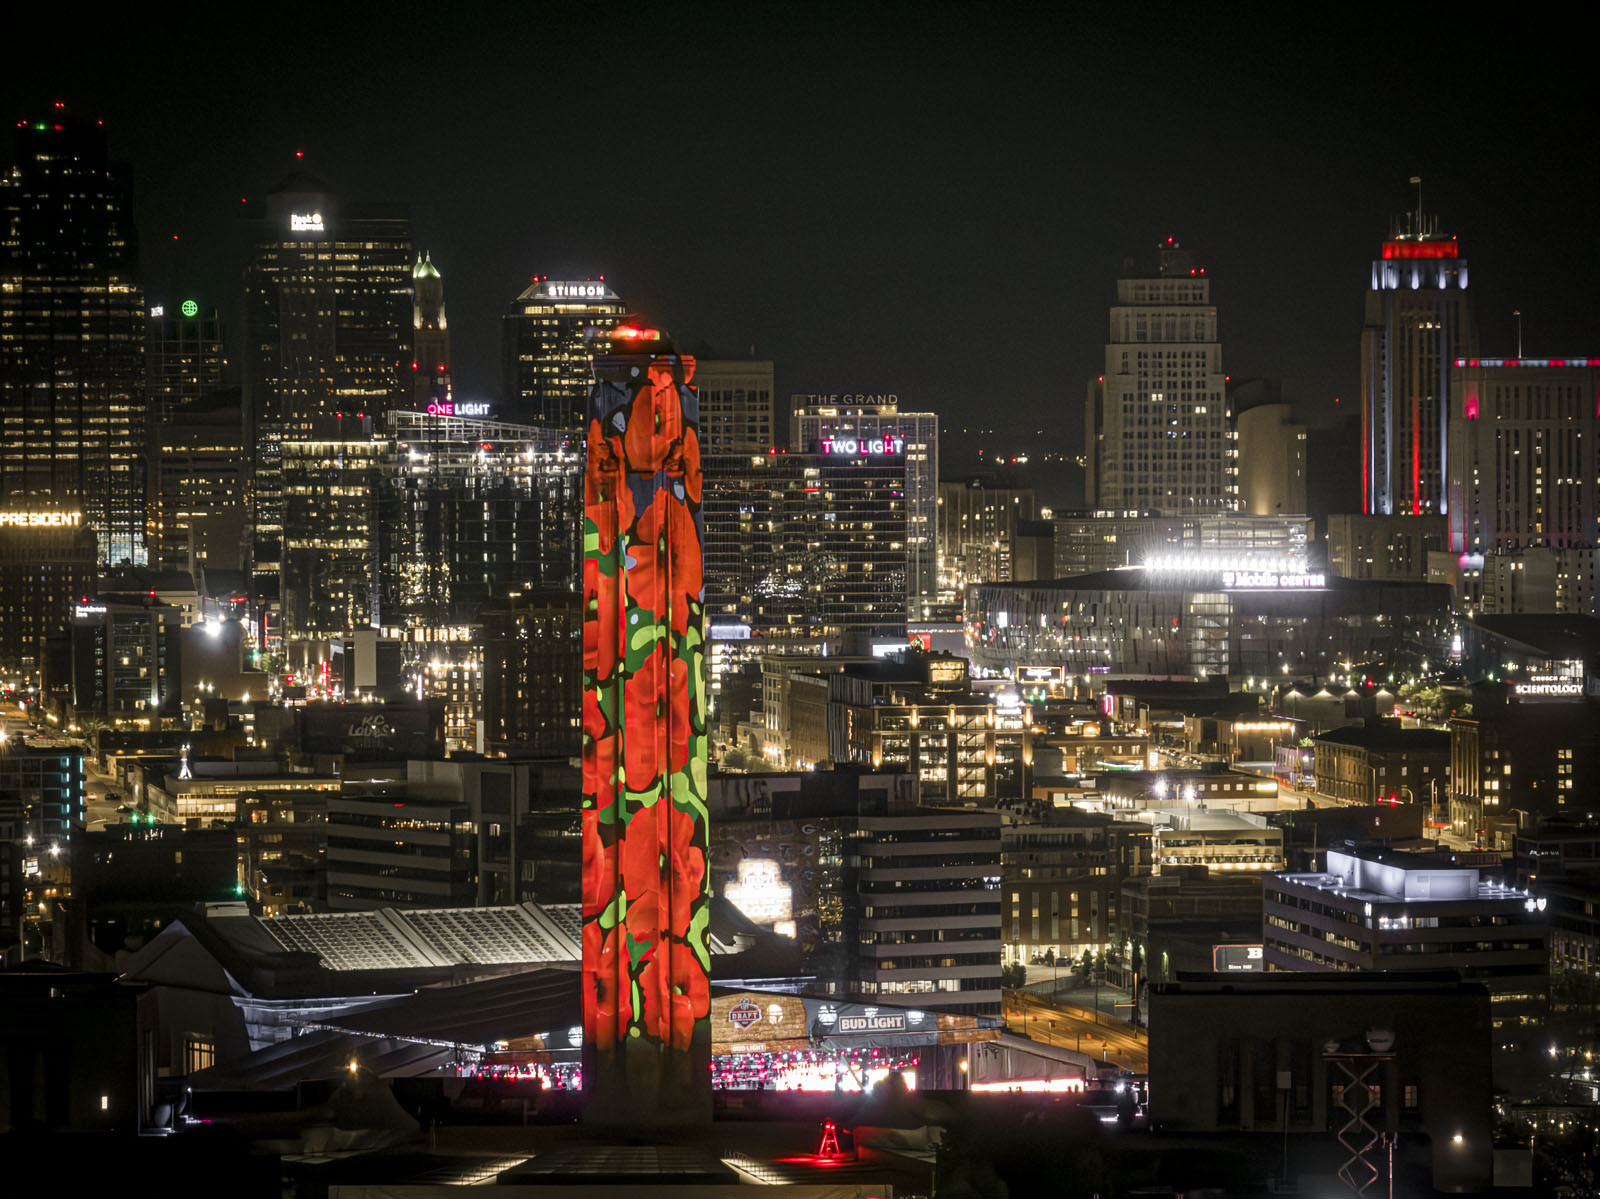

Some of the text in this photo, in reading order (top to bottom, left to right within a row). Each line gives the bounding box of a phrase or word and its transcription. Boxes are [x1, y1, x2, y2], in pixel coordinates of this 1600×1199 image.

[548, 286, 604, 296] STINSON
[808, 394, 898, 404] THE GRAND
[427, 402, 490, 415] ONE LIGHT
[822, 440, 904, 454] TWO LIGHT
[0, 512, 82, 526] PRESIDENT
[1280, 574, 1325, 586] CENTER
[1515, 684, 1584, 694] SCIENTOLOGY
[731, 1012, 758, 1021] DRAFT
[841, 1016, 902, 1030] BUD LIGHT
